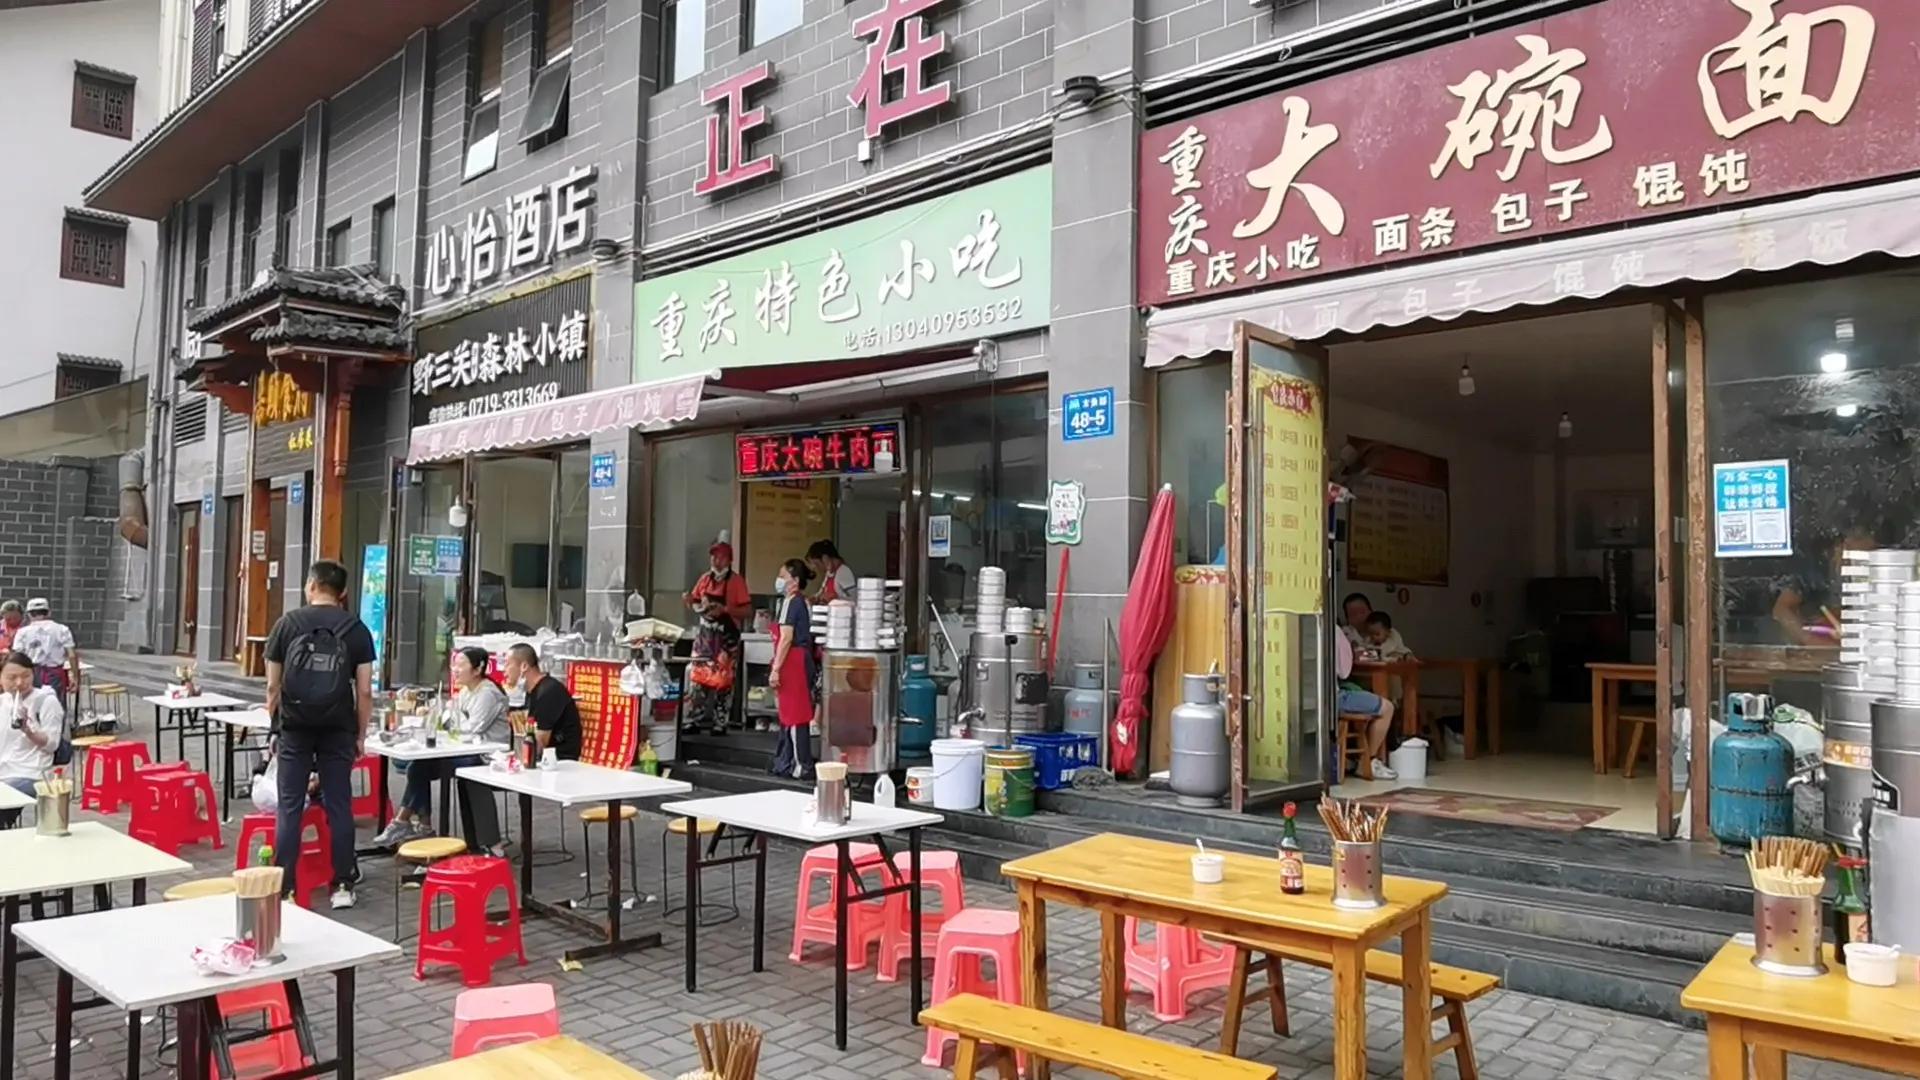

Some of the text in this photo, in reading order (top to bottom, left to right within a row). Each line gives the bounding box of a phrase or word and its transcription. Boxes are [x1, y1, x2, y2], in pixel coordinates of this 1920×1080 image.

[693, 0, 952, 196] 正在
[1232, 0, 1876, 238] 大碗面
[425, 164, 598, 295] 心怡酒店
[1158, 124, 1209, 263] 重庆
[1166, 149, 1750, 296] 重庆小吃 面条 包子 馄饨
[650, 208, 1024, 362] 重庆特色小吃
[1070, 409, 1106, 429] 48-5
